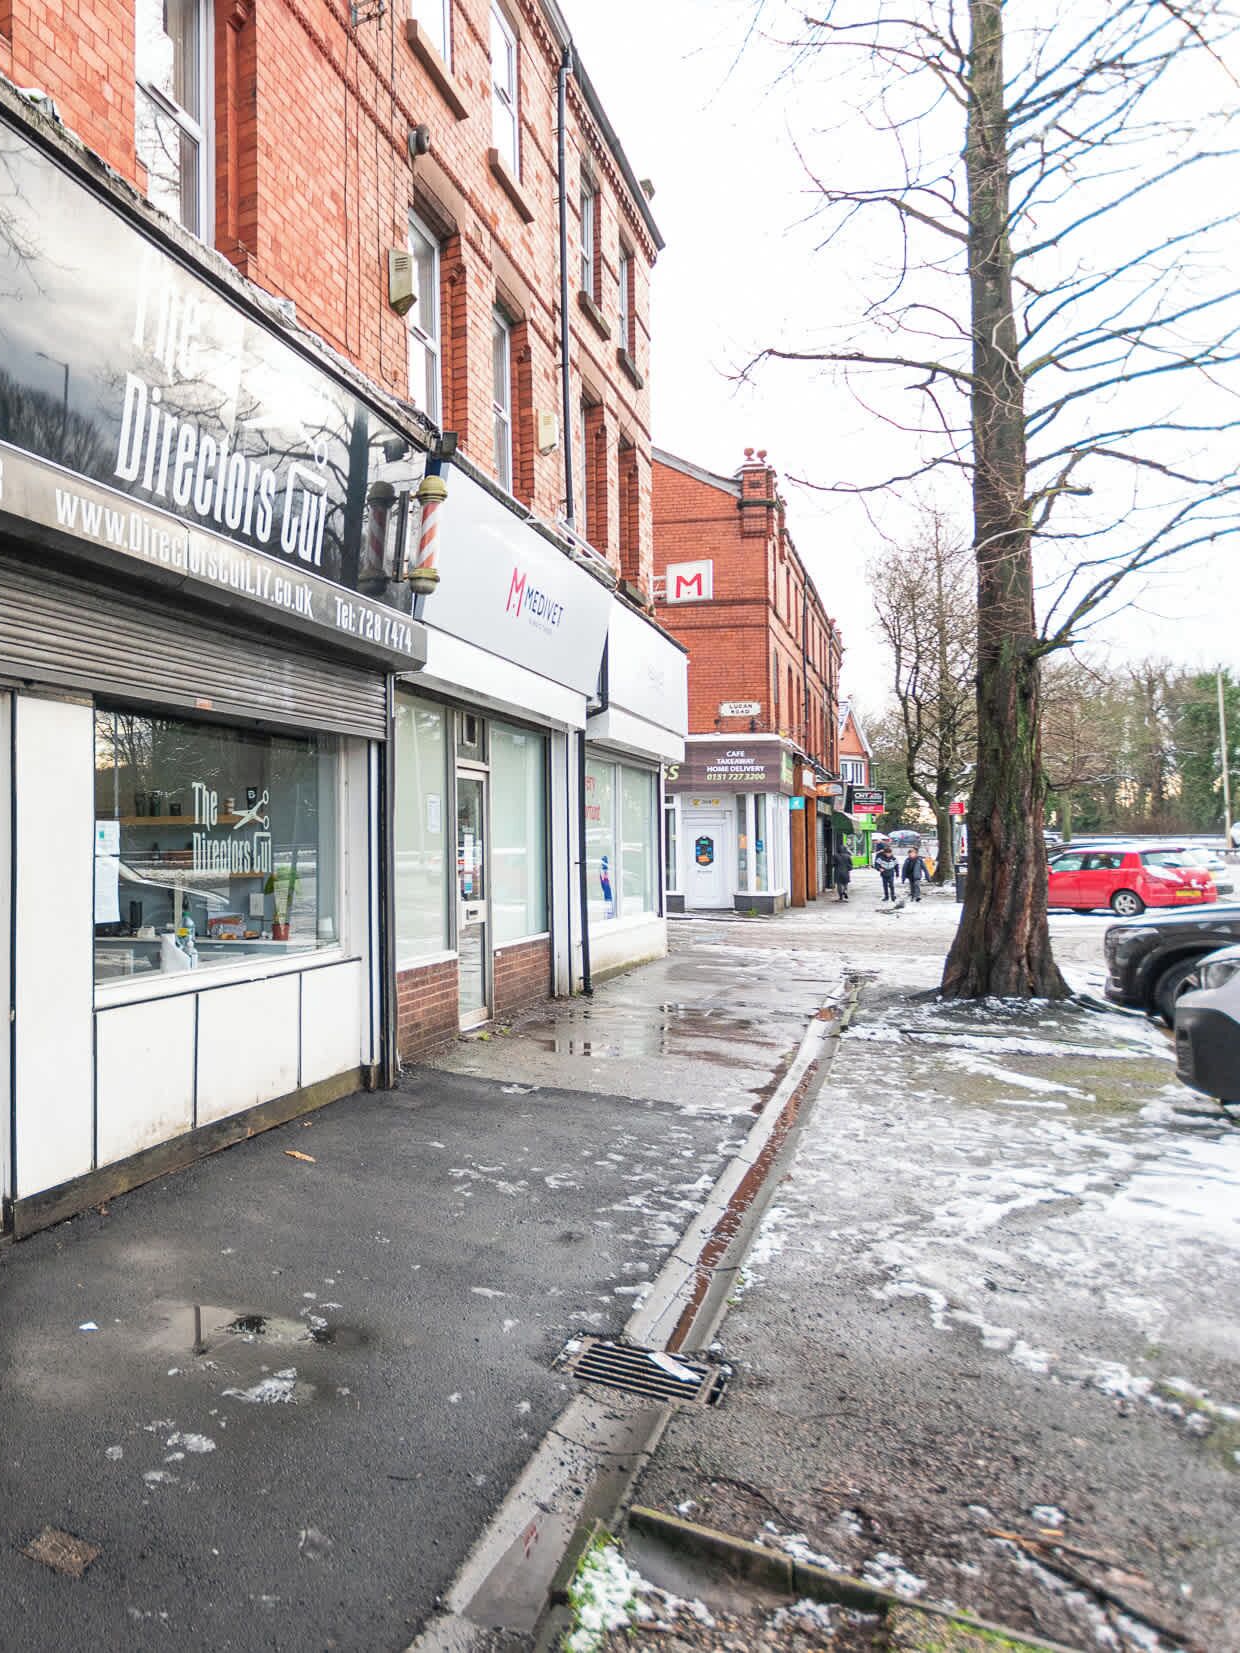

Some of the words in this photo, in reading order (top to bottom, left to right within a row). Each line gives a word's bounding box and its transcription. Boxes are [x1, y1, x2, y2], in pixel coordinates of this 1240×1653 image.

[114, 372, 276, 544] Directors
[281, 461, 328, 567] Cut
[334, 596, 356, 632] Tel:
[358, 606, 382, 641] 728
[384, 617, 413, 653] 7474
[524, 586, 564, 627] MEDIVET
[191, 781, 218, 831] The
[192, 832, 251, 873] Directors
[253, 831, 272, 873] Cut
